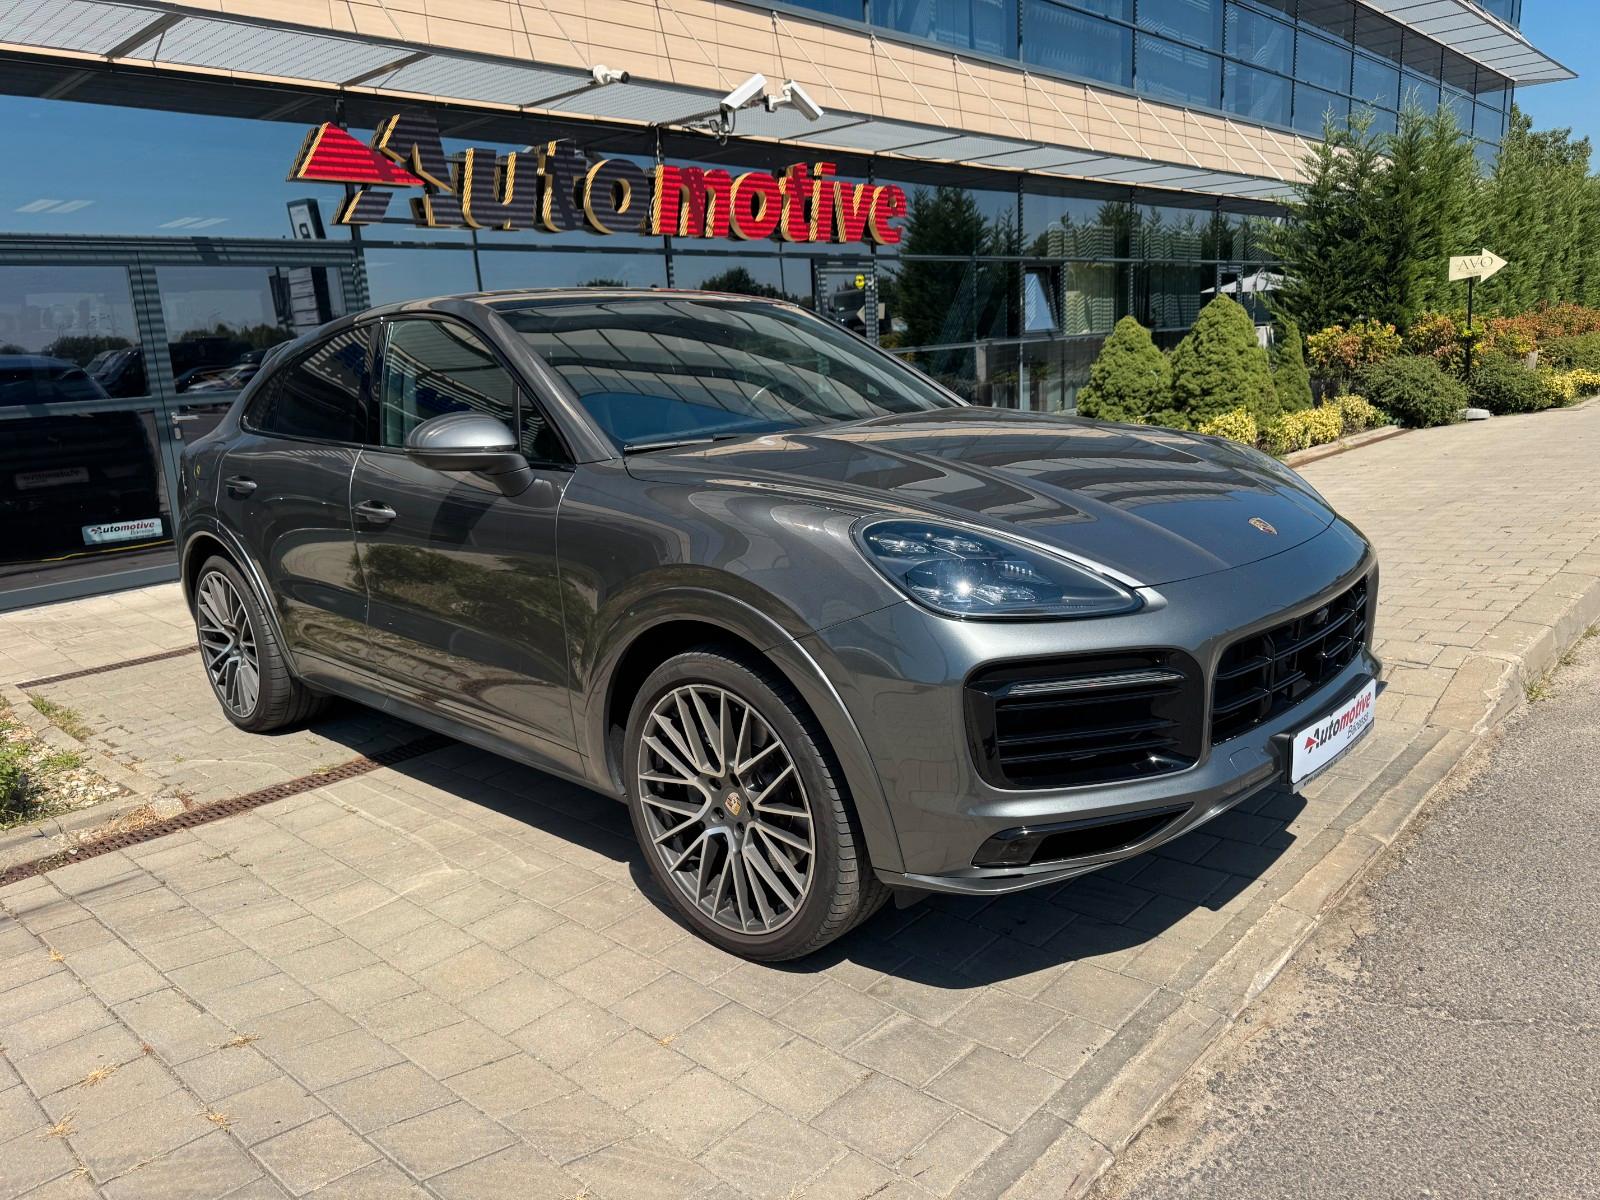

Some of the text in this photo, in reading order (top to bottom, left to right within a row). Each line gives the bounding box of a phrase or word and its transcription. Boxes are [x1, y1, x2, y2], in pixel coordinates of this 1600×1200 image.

[332, 112, 907, 246] Automotive
[1457, 255, 1493, 271] AVO
[91, 521, 155, 535] Automotive
[1305, 691, 1371, 754] Automotive
